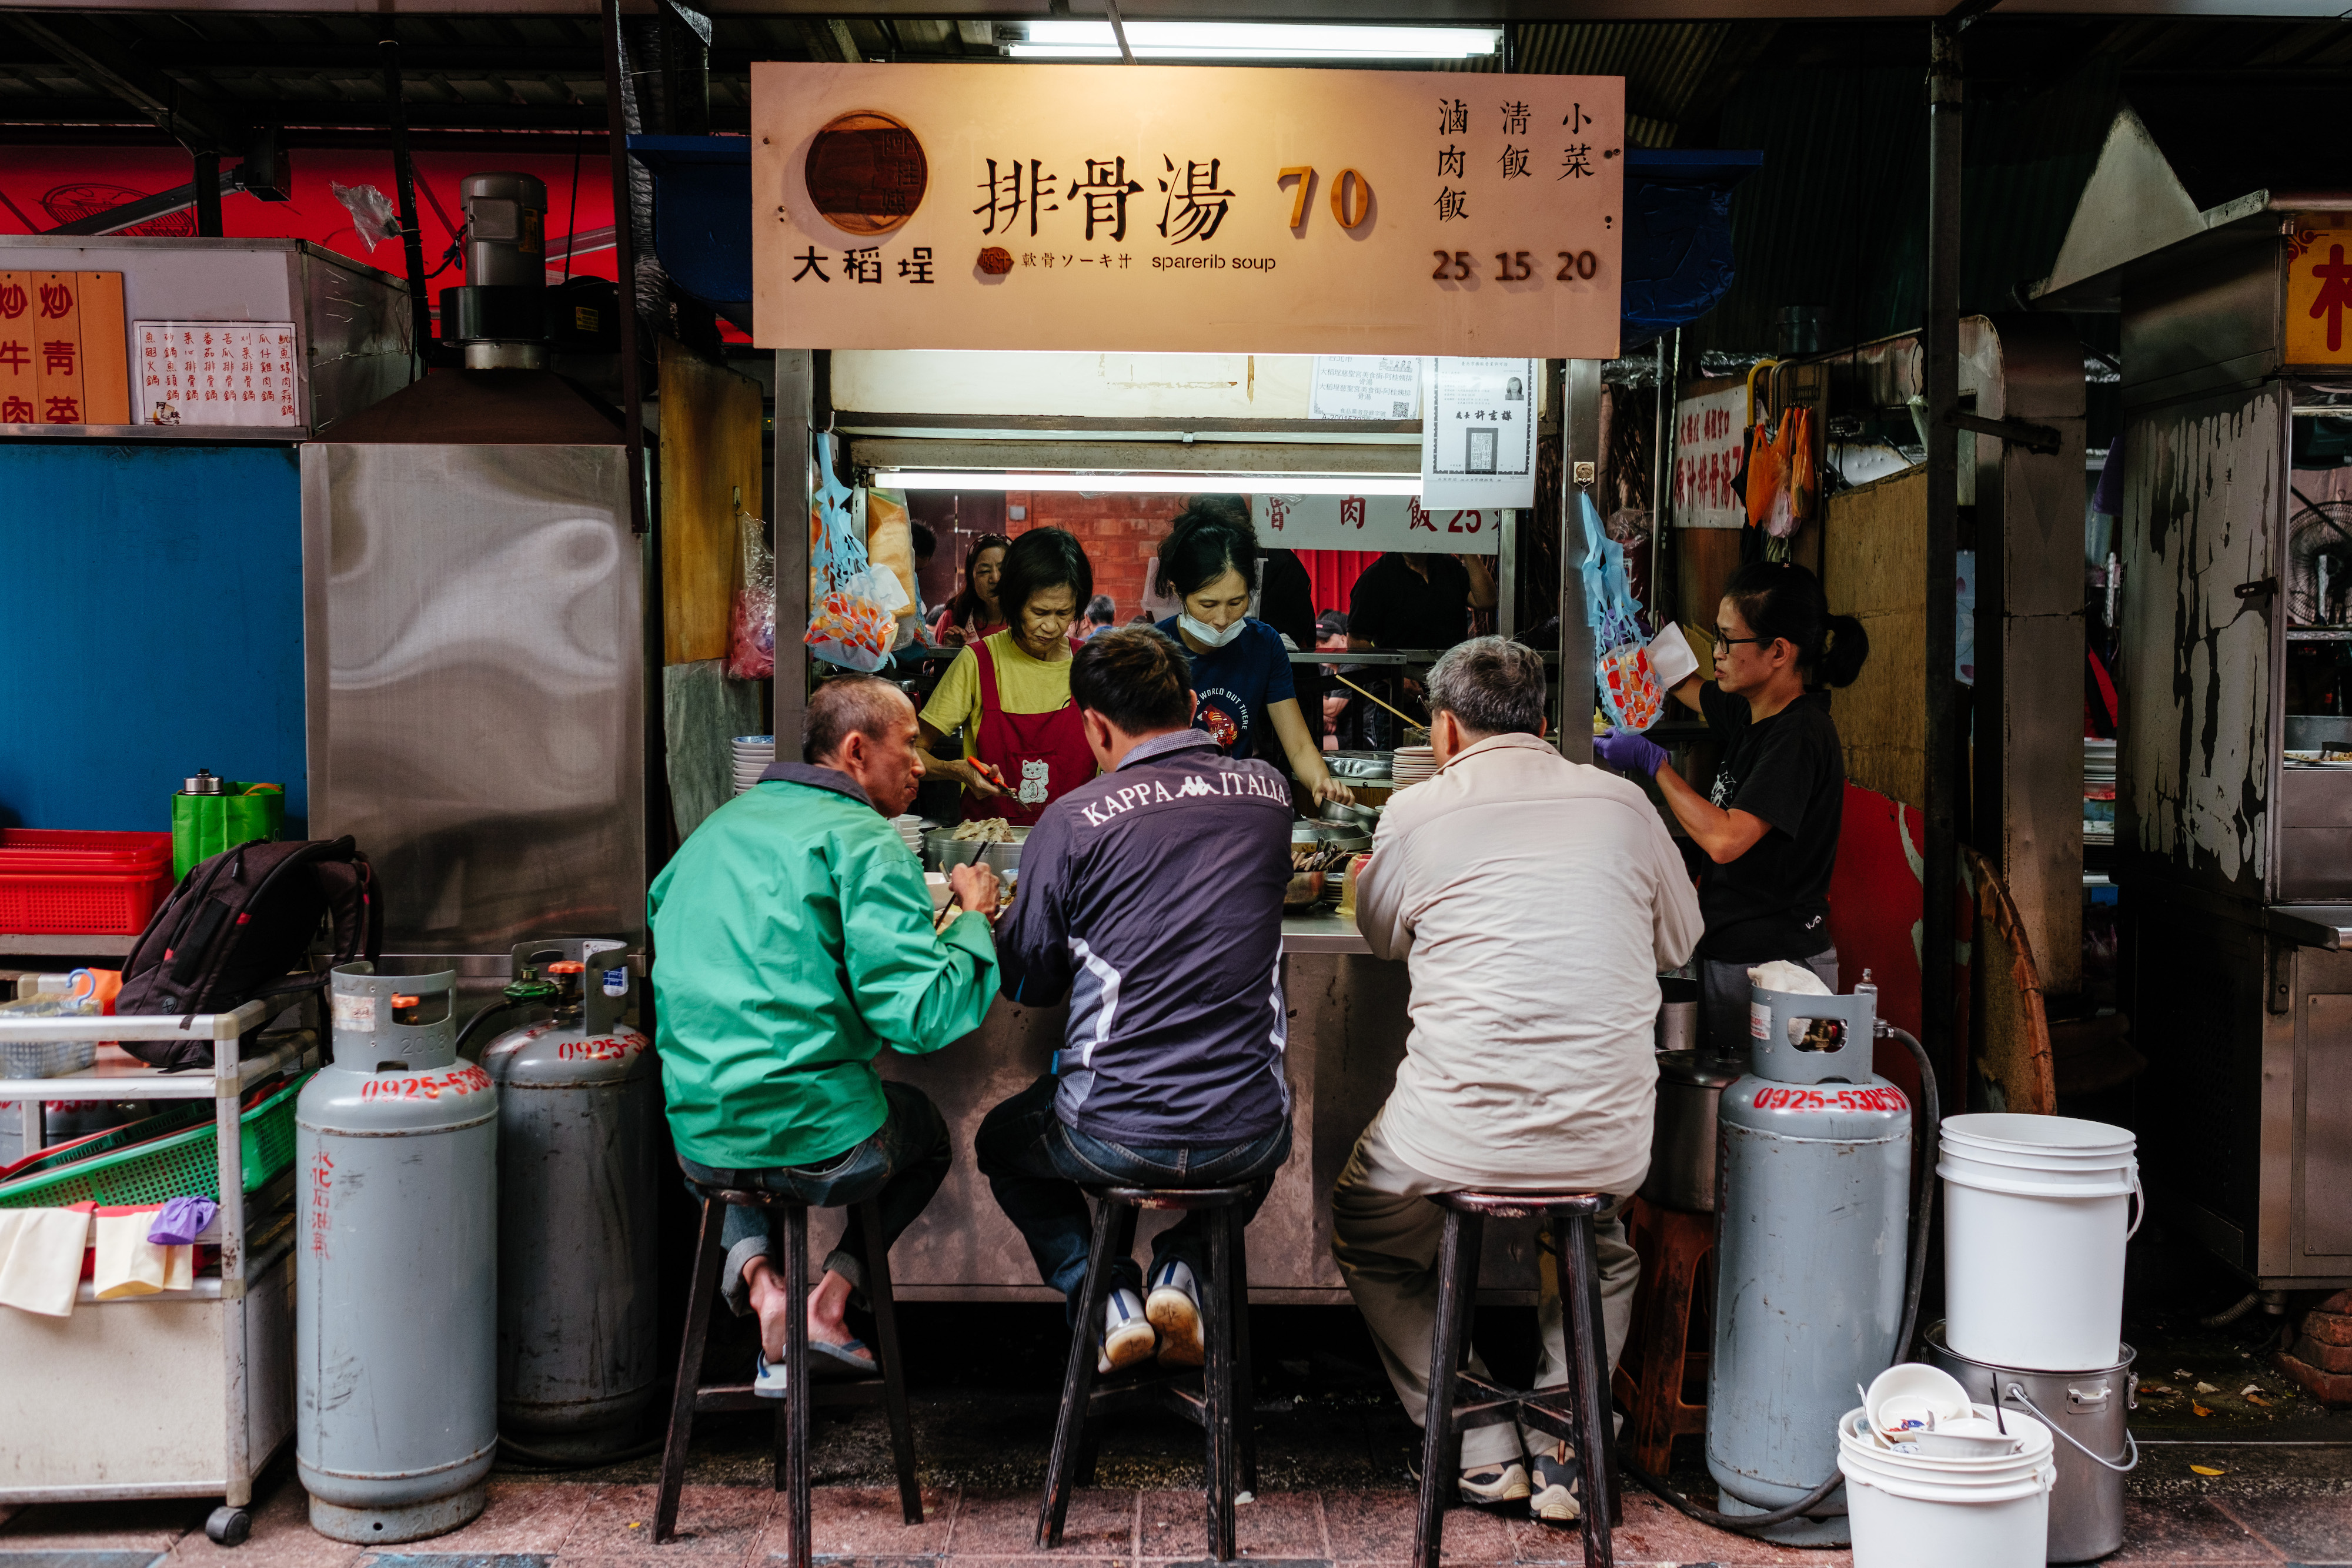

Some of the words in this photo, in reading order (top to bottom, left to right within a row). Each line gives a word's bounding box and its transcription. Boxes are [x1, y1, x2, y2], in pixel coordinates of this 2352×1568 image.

[1433, 98, 1469, 222] 滷肉飯
[1496, 100, 1532, 180] 清飯
[1556, 102, 1595, 180] 小菜
[973, 153, 1236, 245] 排骨湯
[1277, 165, 1369, 229] 70
[792, 245, 935, 285] 大稻埕
[1021, 252, 1132, 269] 軟骨ソーキ汁
[1151, 254, 1226, 272] sparerib
[1232, 257, 1277, 273] soup
[1432, 250, 1471, 281] 25
[1495, 252, 1532, 282] 15
[1556, 250, 1596, 282] 20
[39, 283, 79, 424] 炒青菜
[1199, 687, 1224, 700] WORLD
[1225, 691, 1241, 704] OUT
[1239, 704, 1249, 730] THERE
[1081, 780, 1174, 827] KAPPA
[1218, 771, 1289, 807] ITALIA
[558, 1030, 650, 1062] 0925-5
